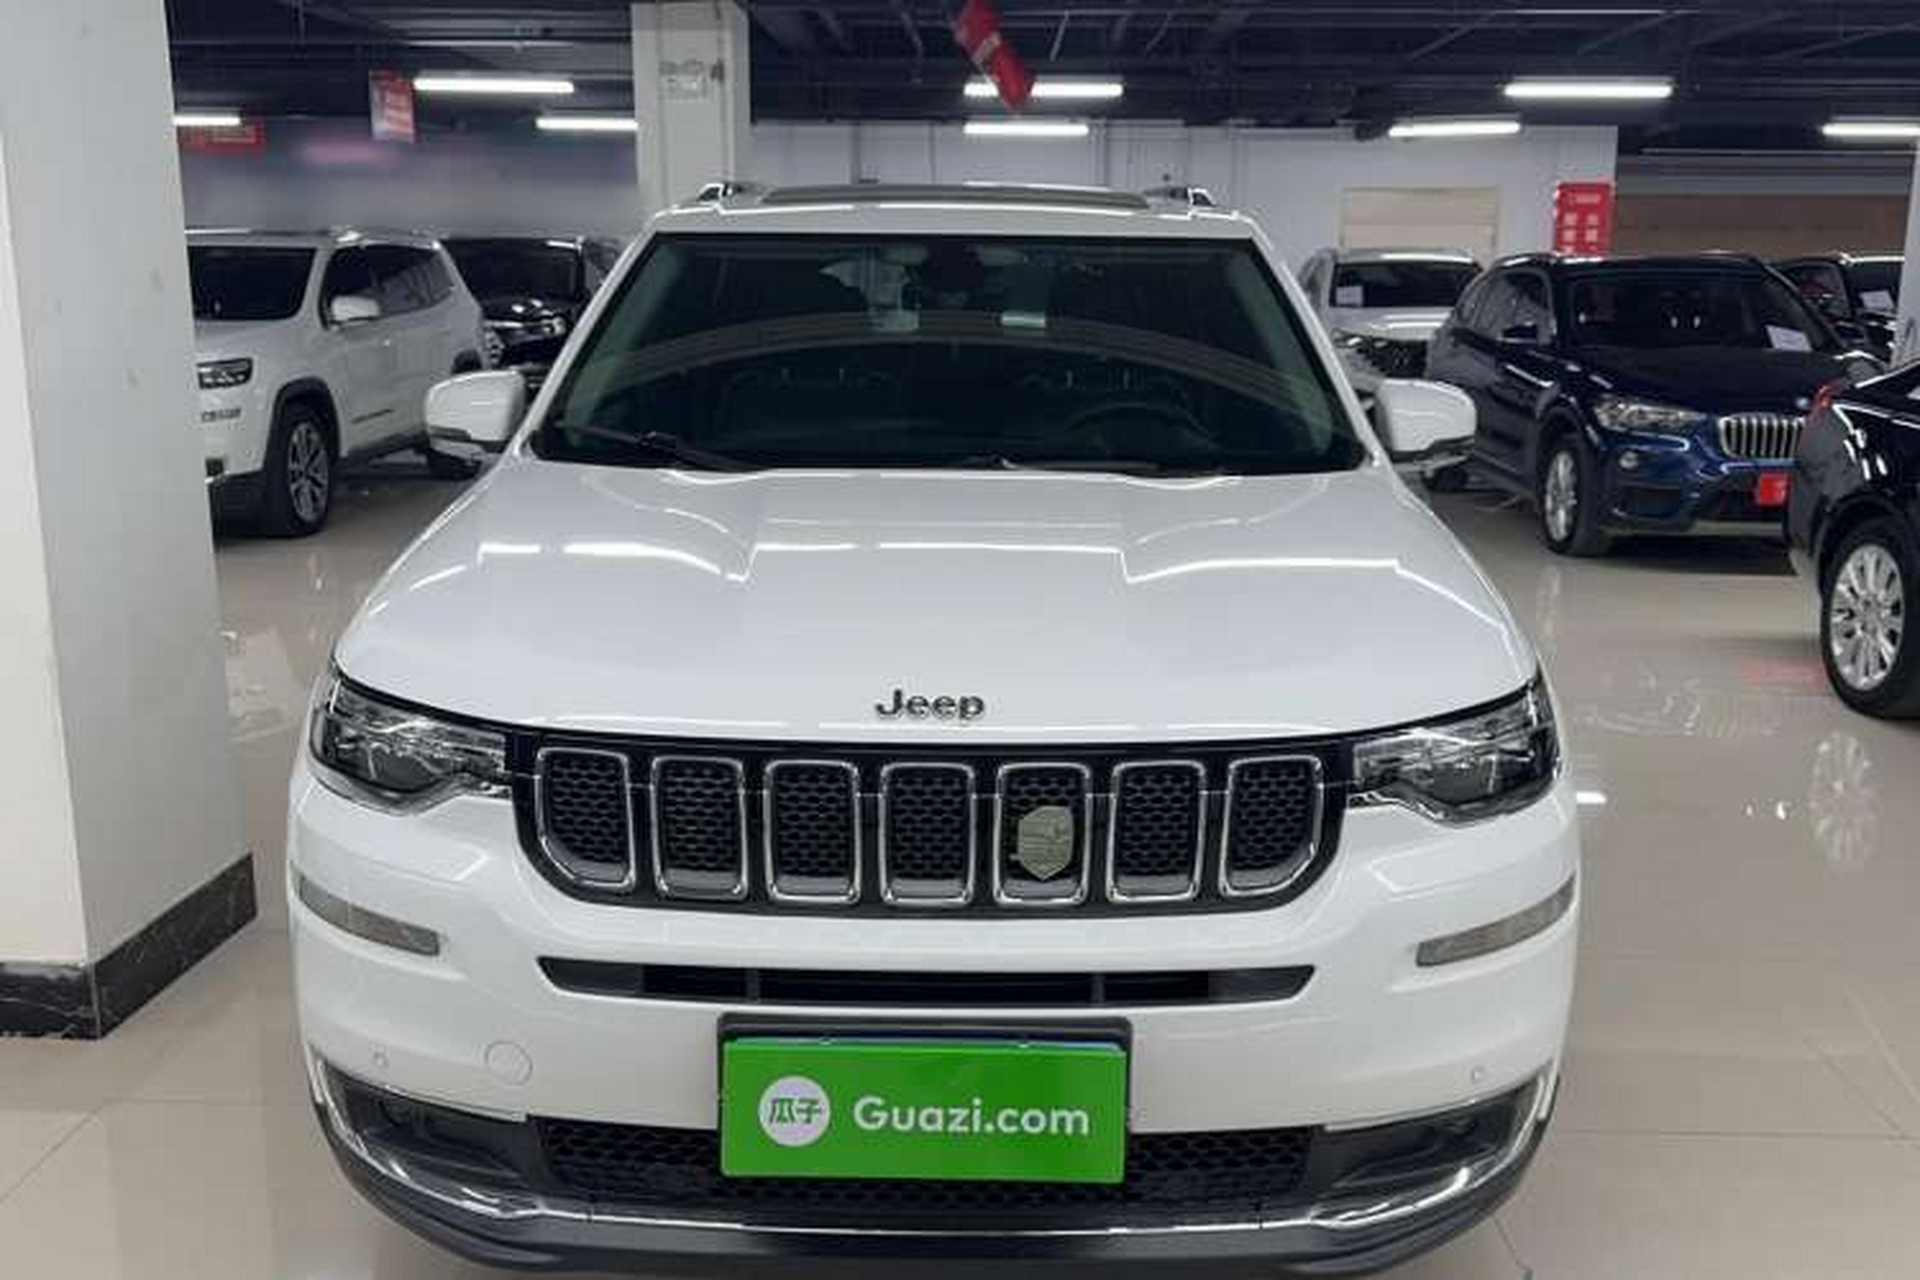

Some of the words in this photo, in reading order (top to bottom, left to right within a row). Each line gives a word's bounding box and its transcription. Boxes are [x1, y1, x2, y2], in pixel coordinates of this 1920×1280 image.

[874, 689, 985, 720] Jeep
[767, 1097, 825, 1126] 瓜子
[853, 1095, 1091, 1137] Guazi.com
